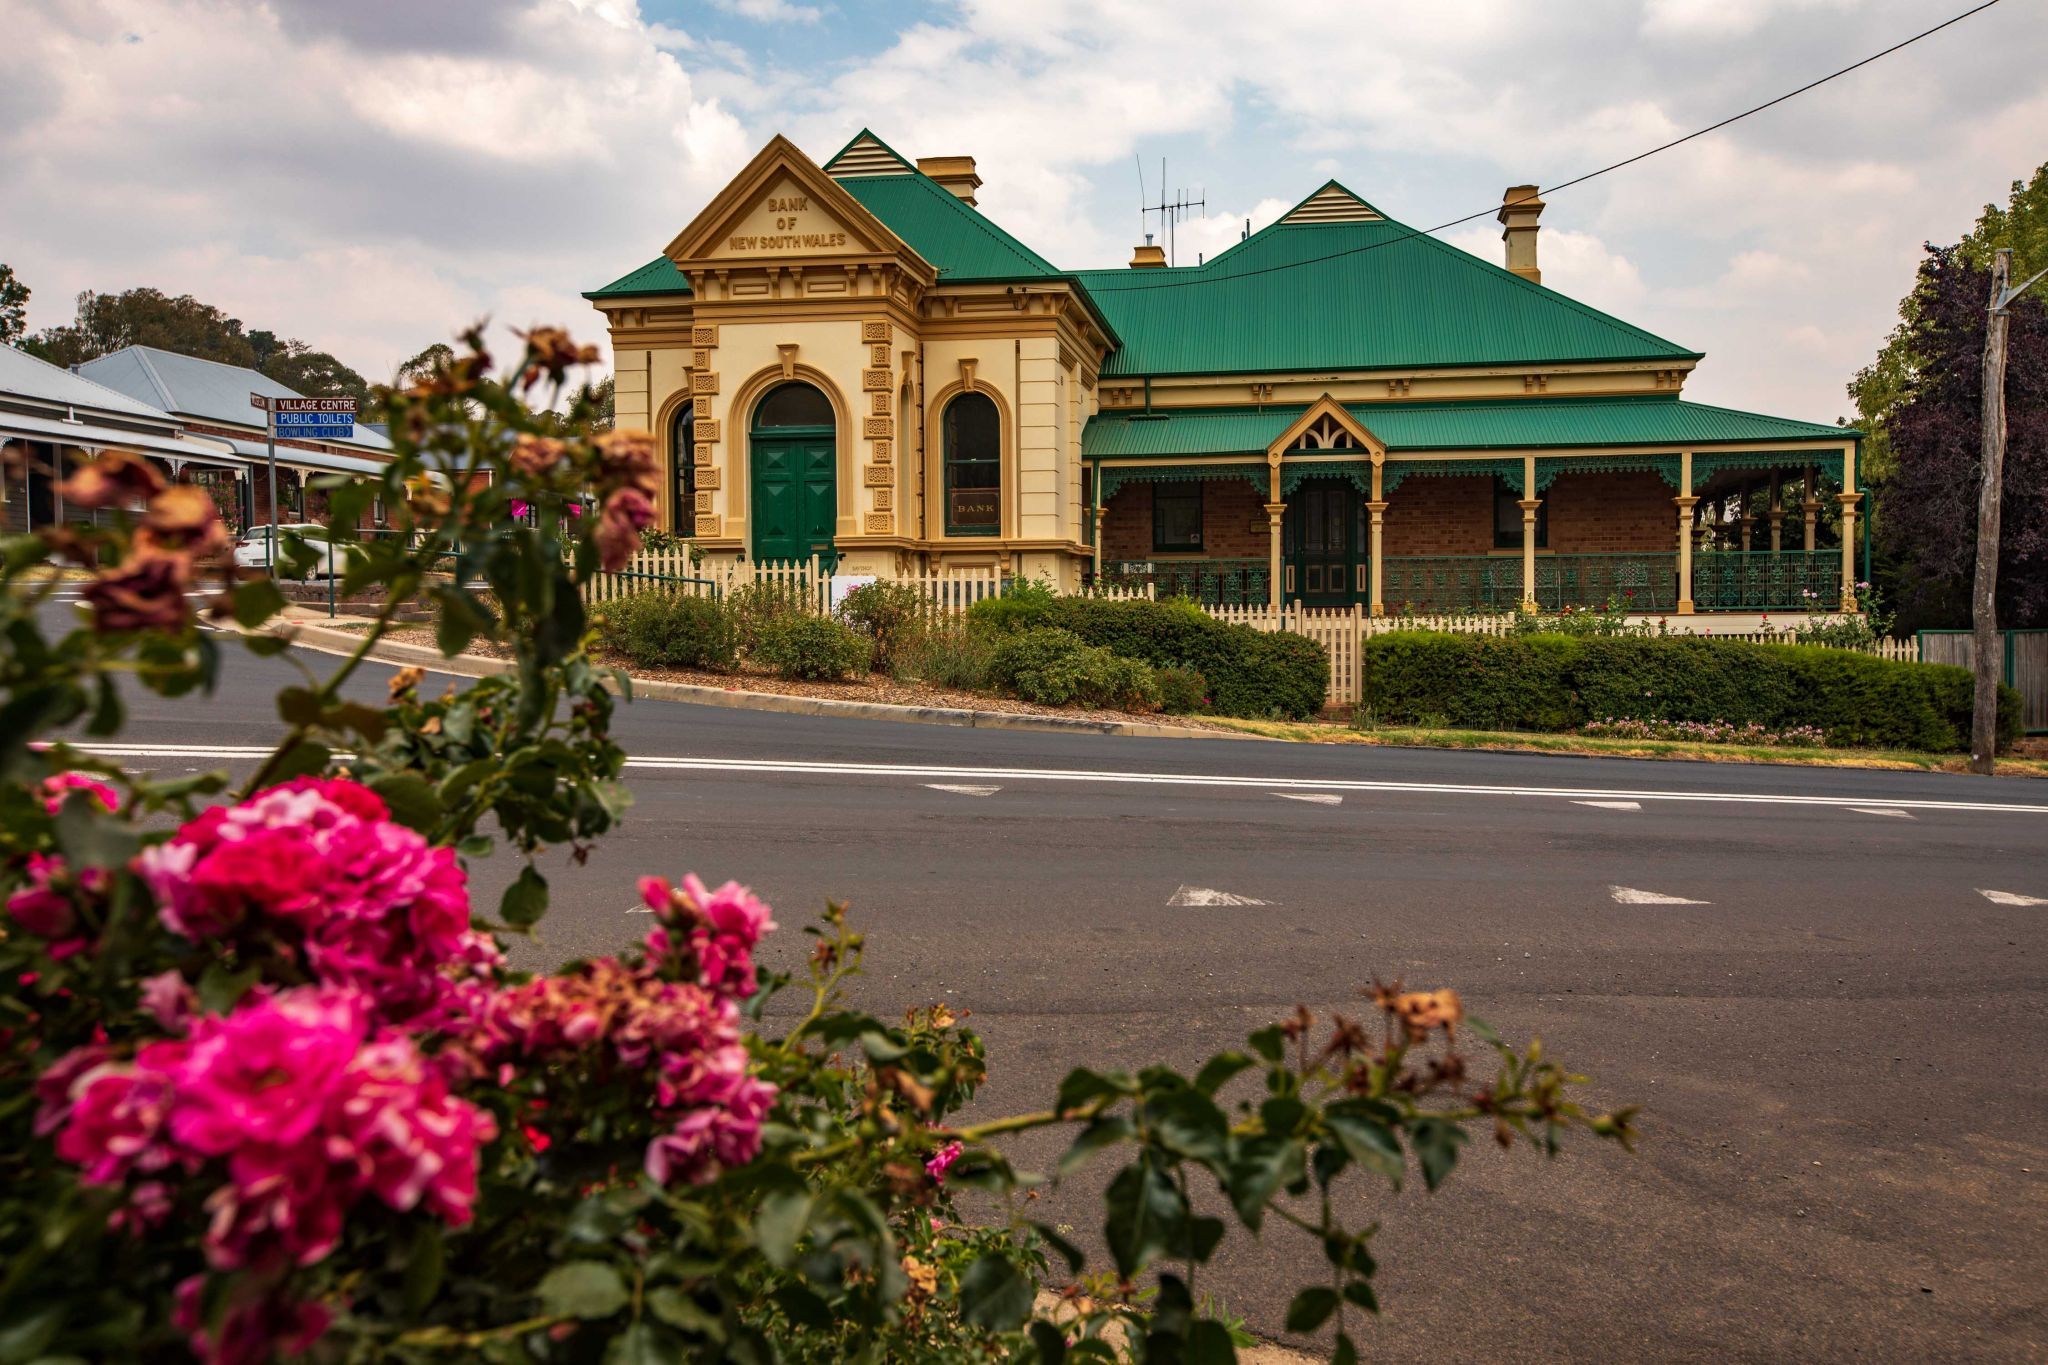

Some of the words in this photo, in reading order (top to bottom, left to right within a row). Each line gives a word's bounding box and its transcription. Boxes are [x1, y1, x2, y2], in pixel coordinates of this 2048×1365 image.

[768, 197, 808, 212] BANK
[777, 217, 797, 230] OF
[729, 236, 758, 250] NEW
[760, 234, 800, 249] SOUTH
[801, 232, 846, 247] WALES
[280, 400, 318, 410] VILLAGE
[320, 400, 356, 410] CENTRE
[280, 413, 314, 424] PUBLIC
[318, 413, 353, 424] TOILETS
[278, 426, 318, 437] BOWLING
[322, 427, 344, 437] CLUB
